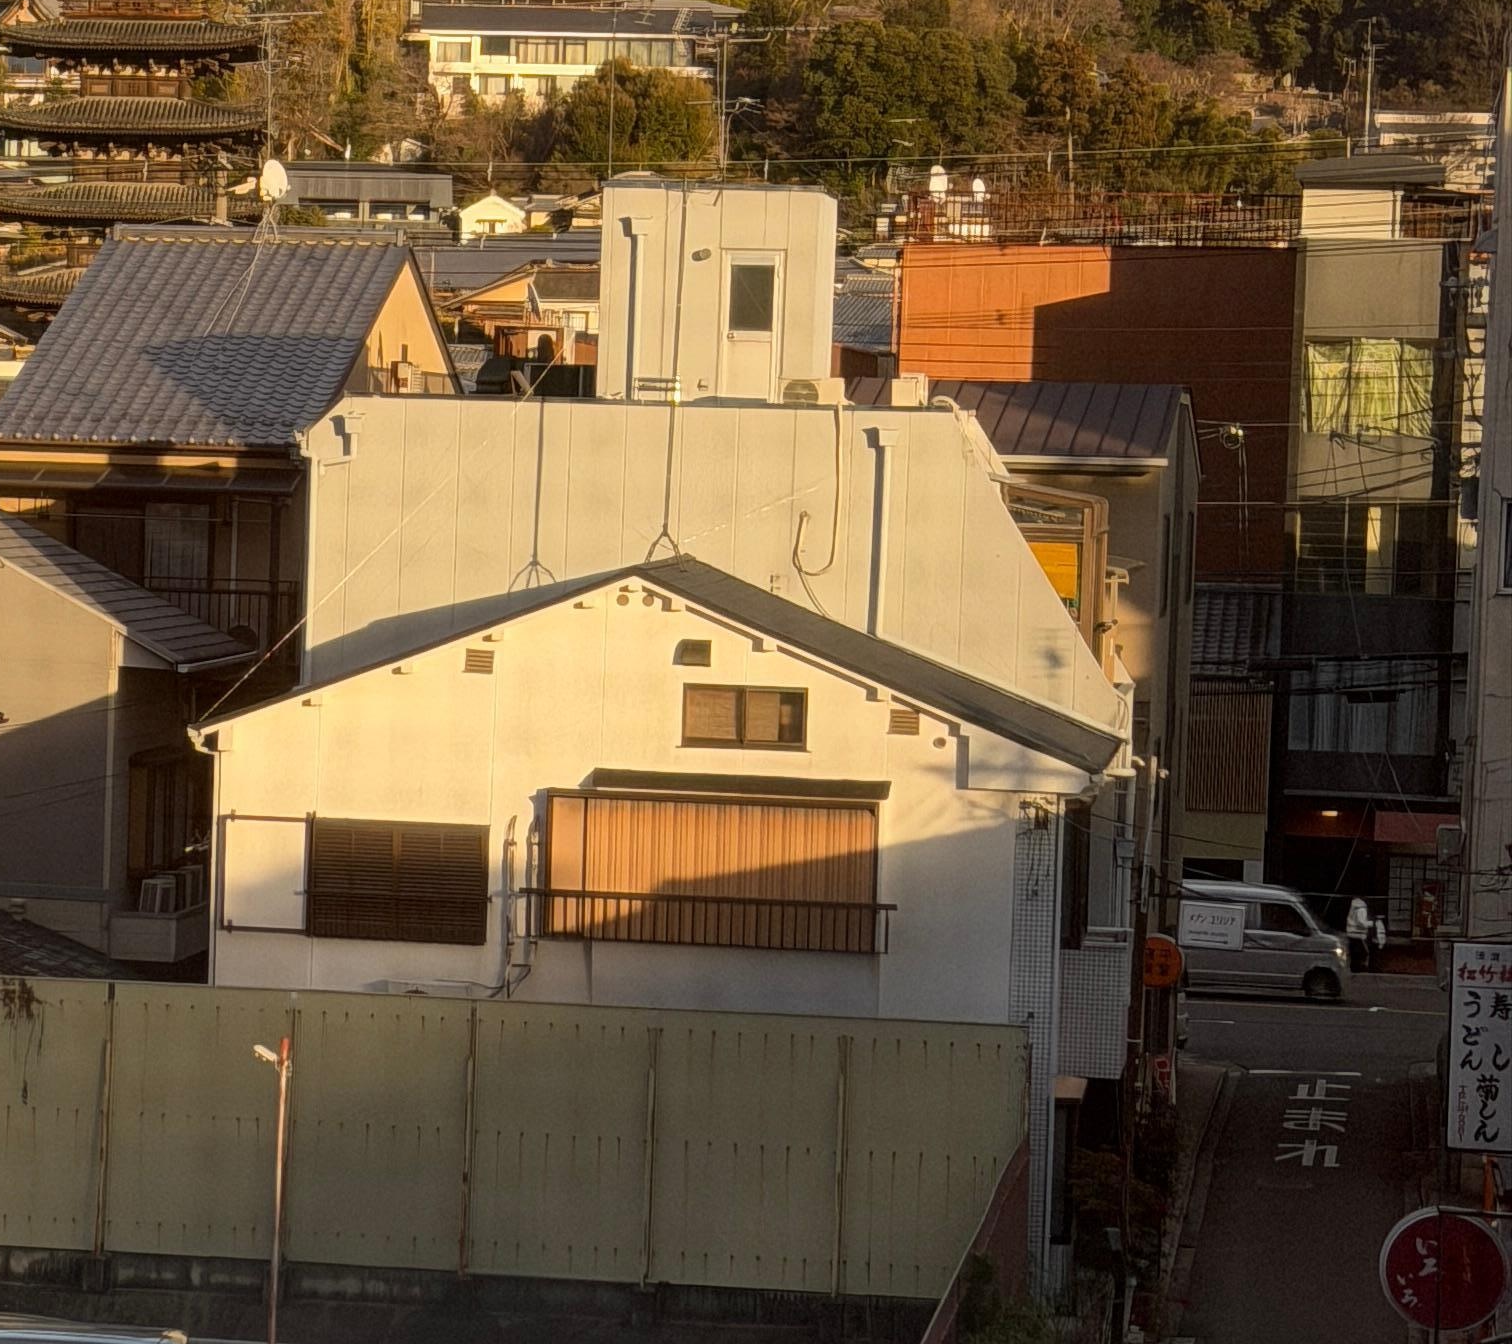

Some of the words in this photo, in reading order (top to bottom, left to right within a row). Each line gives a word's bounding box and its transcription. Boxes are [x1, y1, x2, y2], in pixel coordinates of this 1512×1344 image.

[1460, 991, 1488, 1072] うどん
[1275, 1079, 1352, 1167] 止まれ
